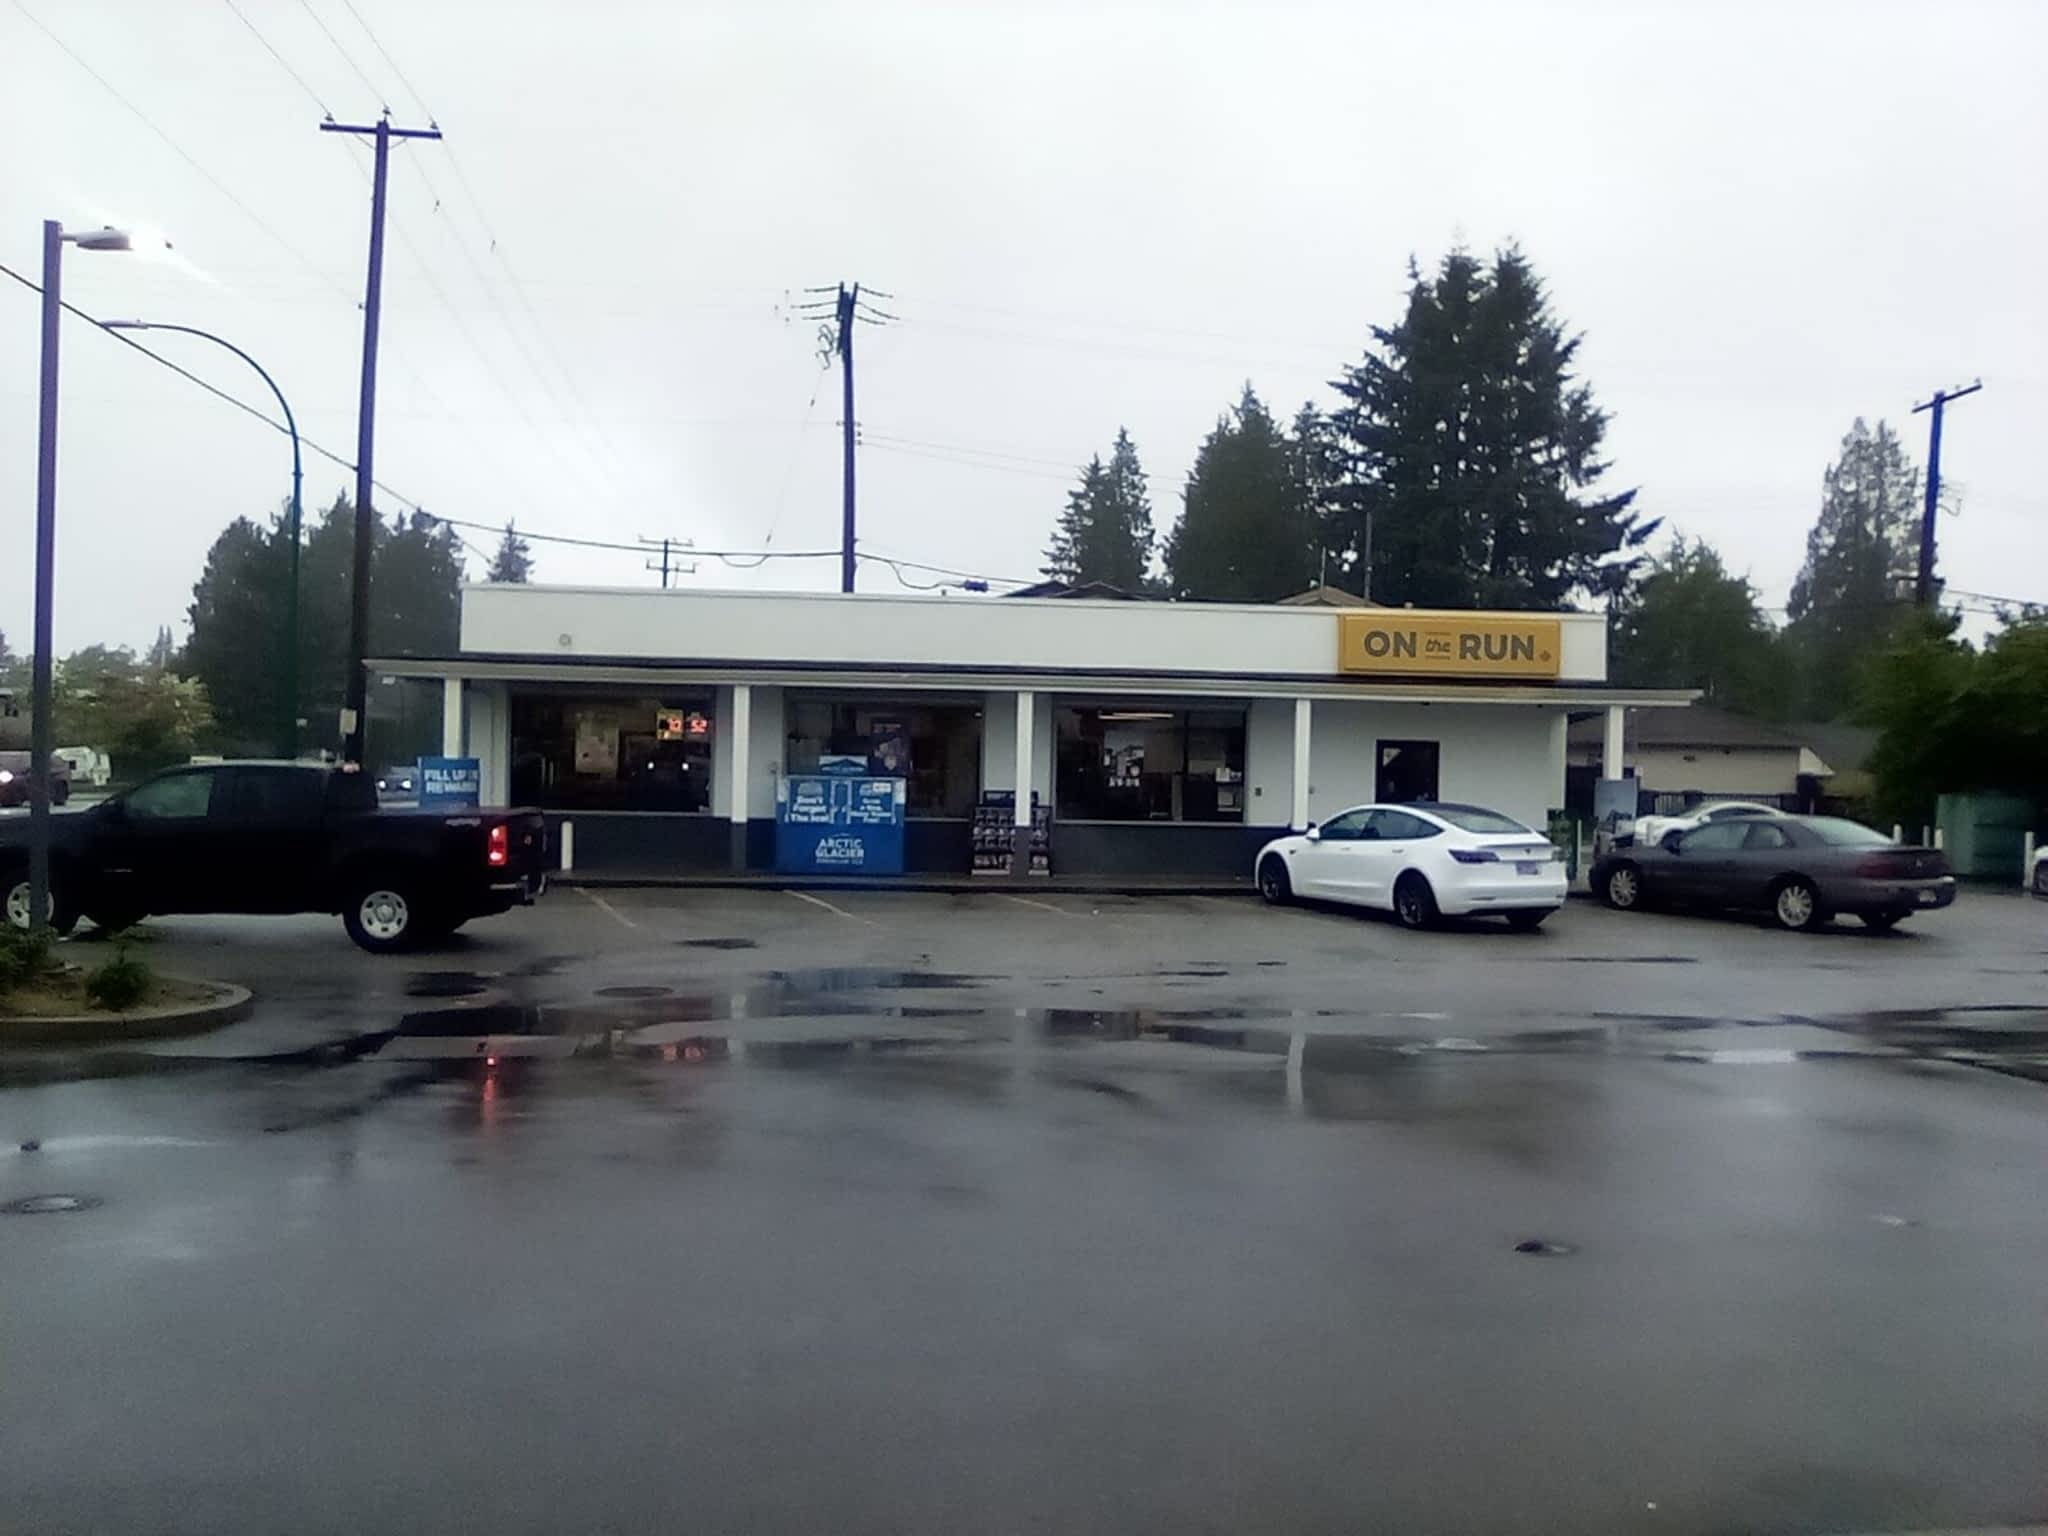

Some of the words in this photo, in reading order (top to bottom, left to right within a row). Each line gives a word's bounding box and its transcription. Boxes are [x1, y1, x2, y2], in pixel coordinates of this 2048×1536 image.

[1364, 630, 1417, 657] ON
[1425, 638, 1451, 653] the
[1459, 634, 1534, 661] RUN
[819, 838, 862, 848] ARCTIC
[815, 848, 864, 858] GLACIER
